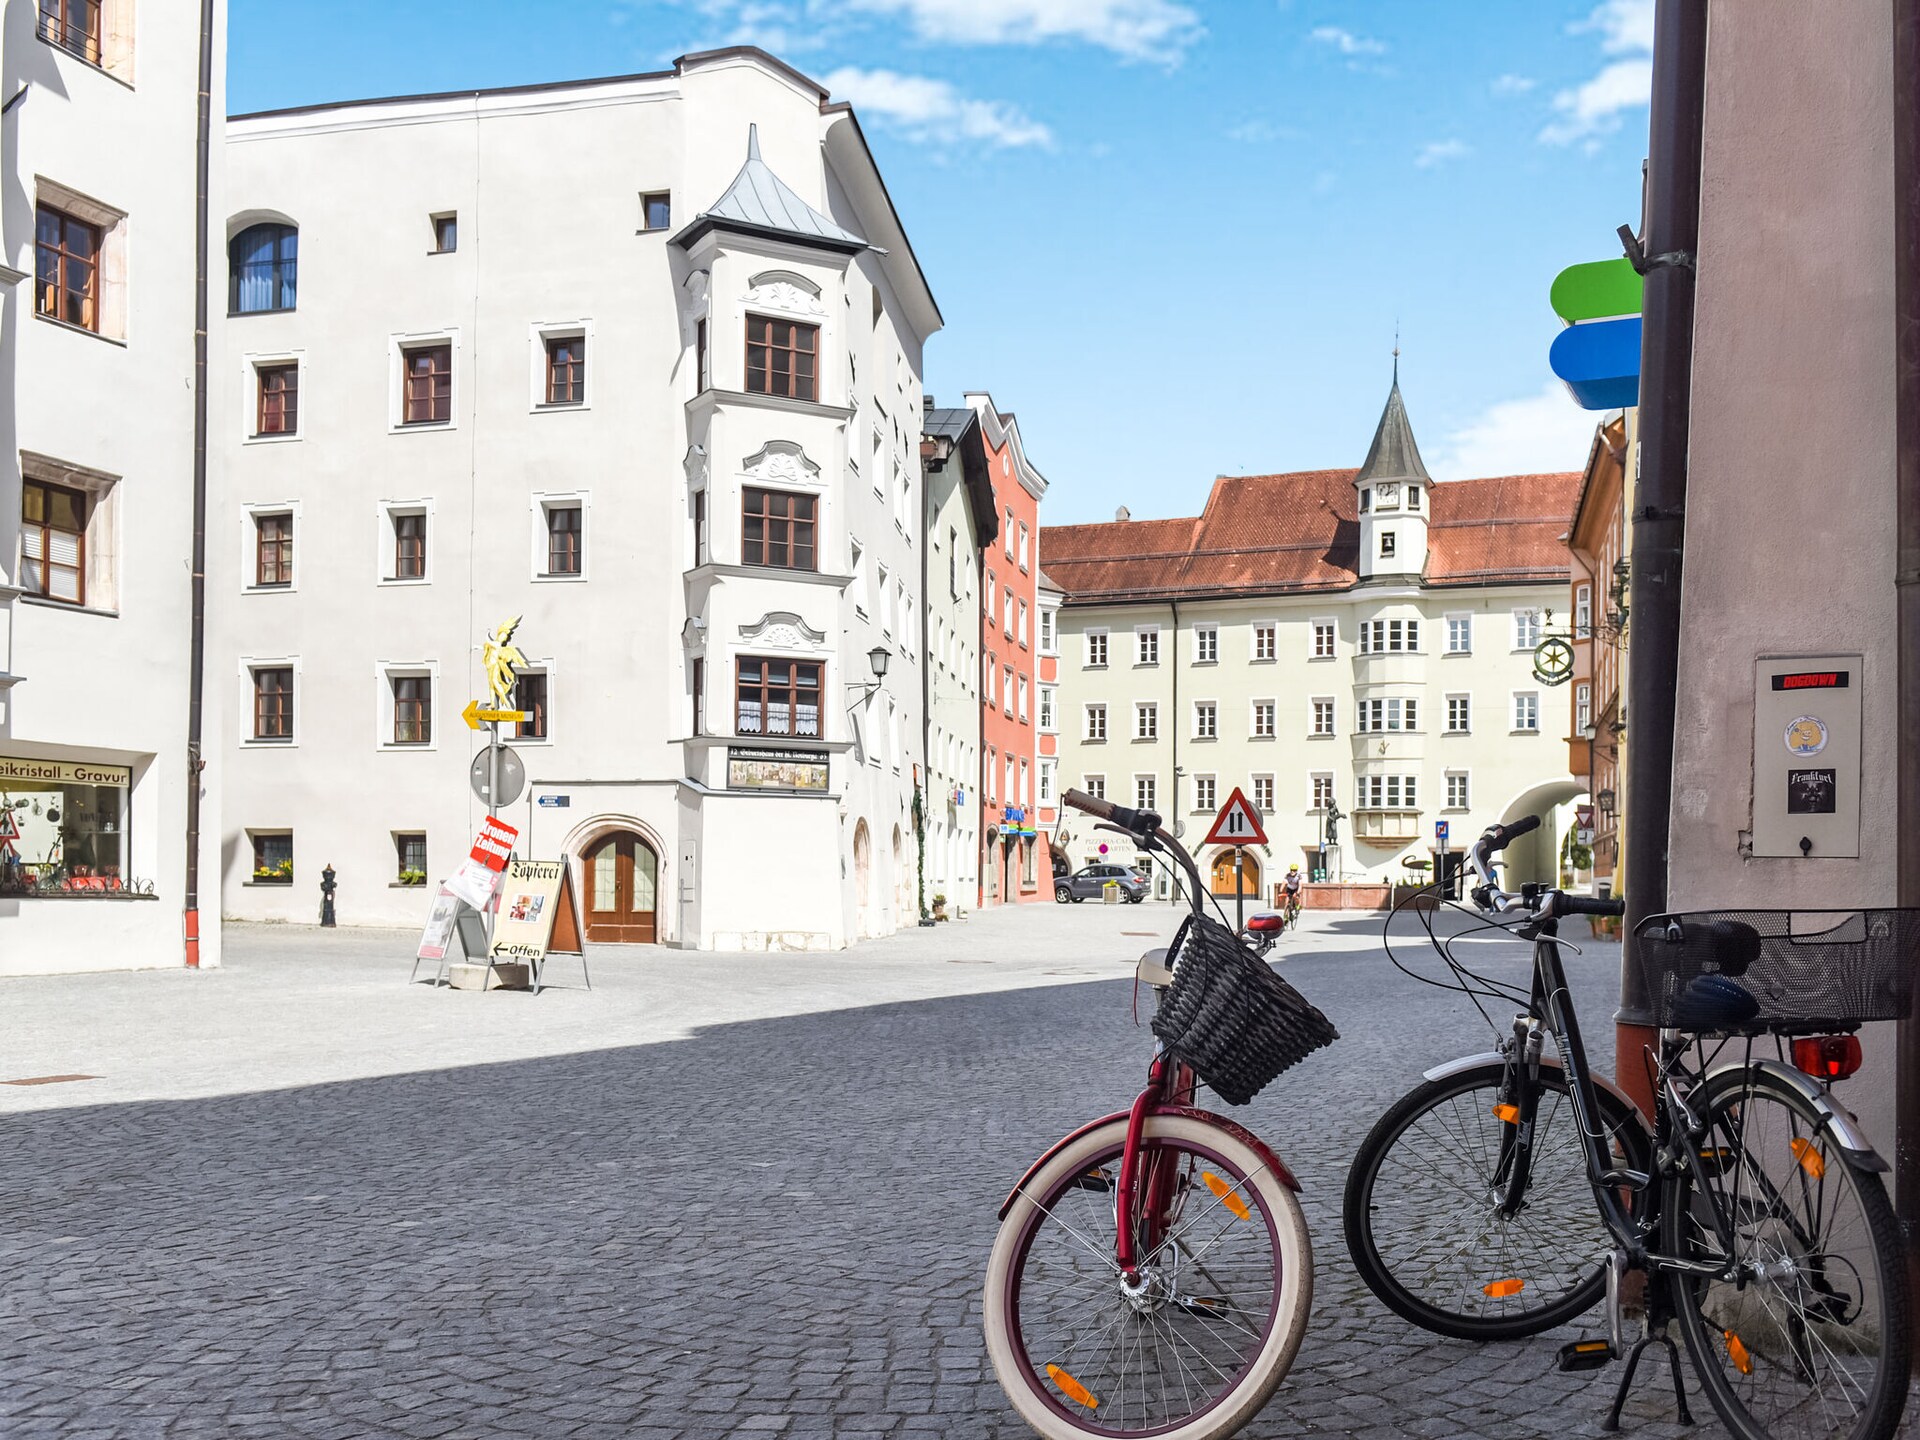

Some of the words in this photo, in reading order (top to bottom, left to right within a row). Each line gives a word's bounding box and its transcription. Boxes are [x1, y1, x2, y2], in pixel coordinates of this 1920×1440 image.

[469, 711, 500, 719] AUGUSTINER
[501, 711, 524, 719] MUSEUM
[74, 767, 127, 783] Gravur
[480, 821, 516, 845] Kronen
[474, 834, 511, 861] Zeitung
[511, 861, 560, 882] Töpferei
[510, 945, 540, 957] Offen
